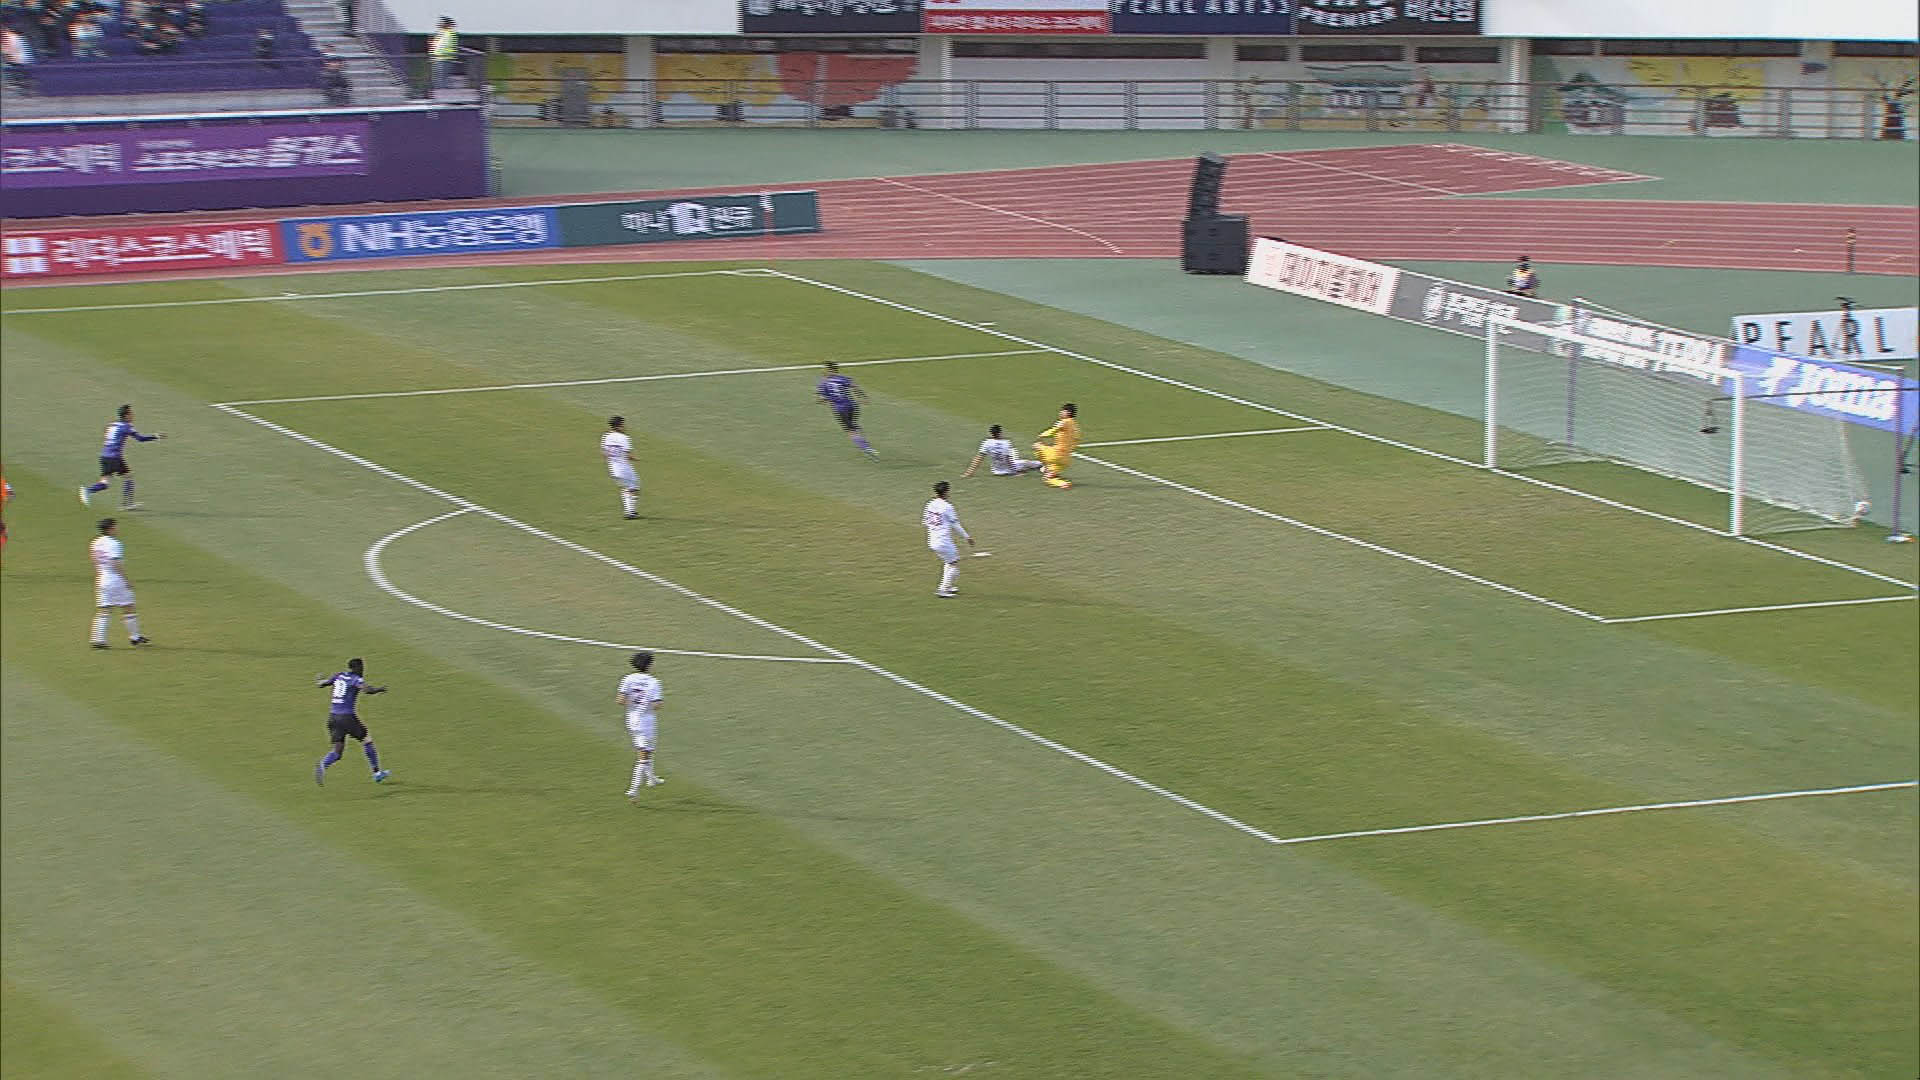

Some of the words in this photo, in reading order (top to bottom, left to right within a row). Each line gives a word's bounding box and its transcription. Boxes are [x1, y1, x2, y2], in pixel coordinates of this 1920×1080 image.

[1298, 6, 1398, 28] PREMIER
[50, 228, 274, 269] 리더스코스메틱
[340, 213, 547, 253] NH농협은행
